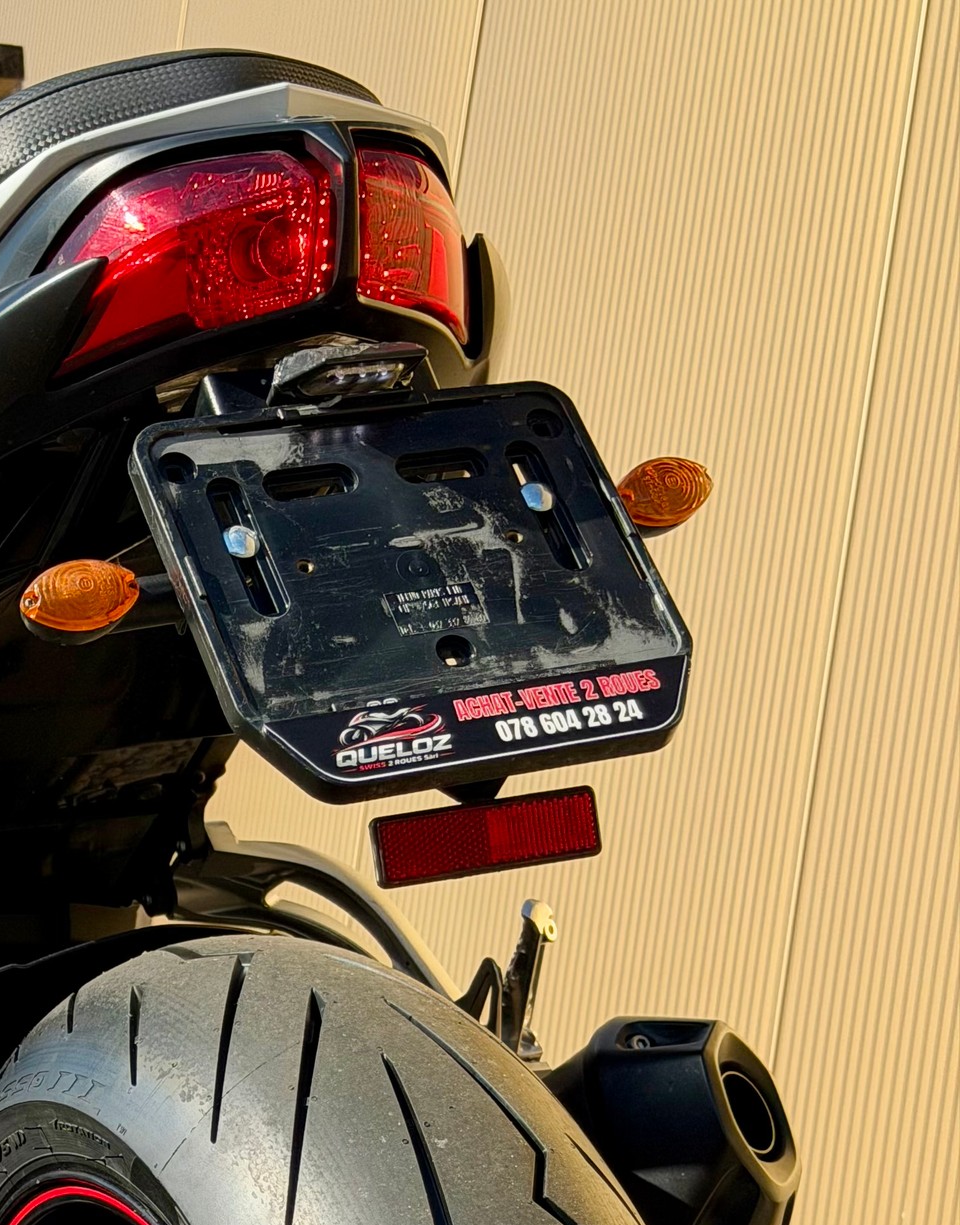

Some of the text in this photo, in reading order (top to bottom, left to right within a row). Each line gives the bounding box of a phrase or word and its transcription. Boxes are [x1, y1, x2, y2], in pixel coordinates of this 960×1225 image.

[453, 669, 661, 722] ACHAT-VENTE 2 ROUES
[495, 699, 644, 742] 078 604 28 24
[336, 734, 452, 768] QUELOZ
[359, 761, 386, 771] SWISS
[394, 755, 423, 766] ROUES
